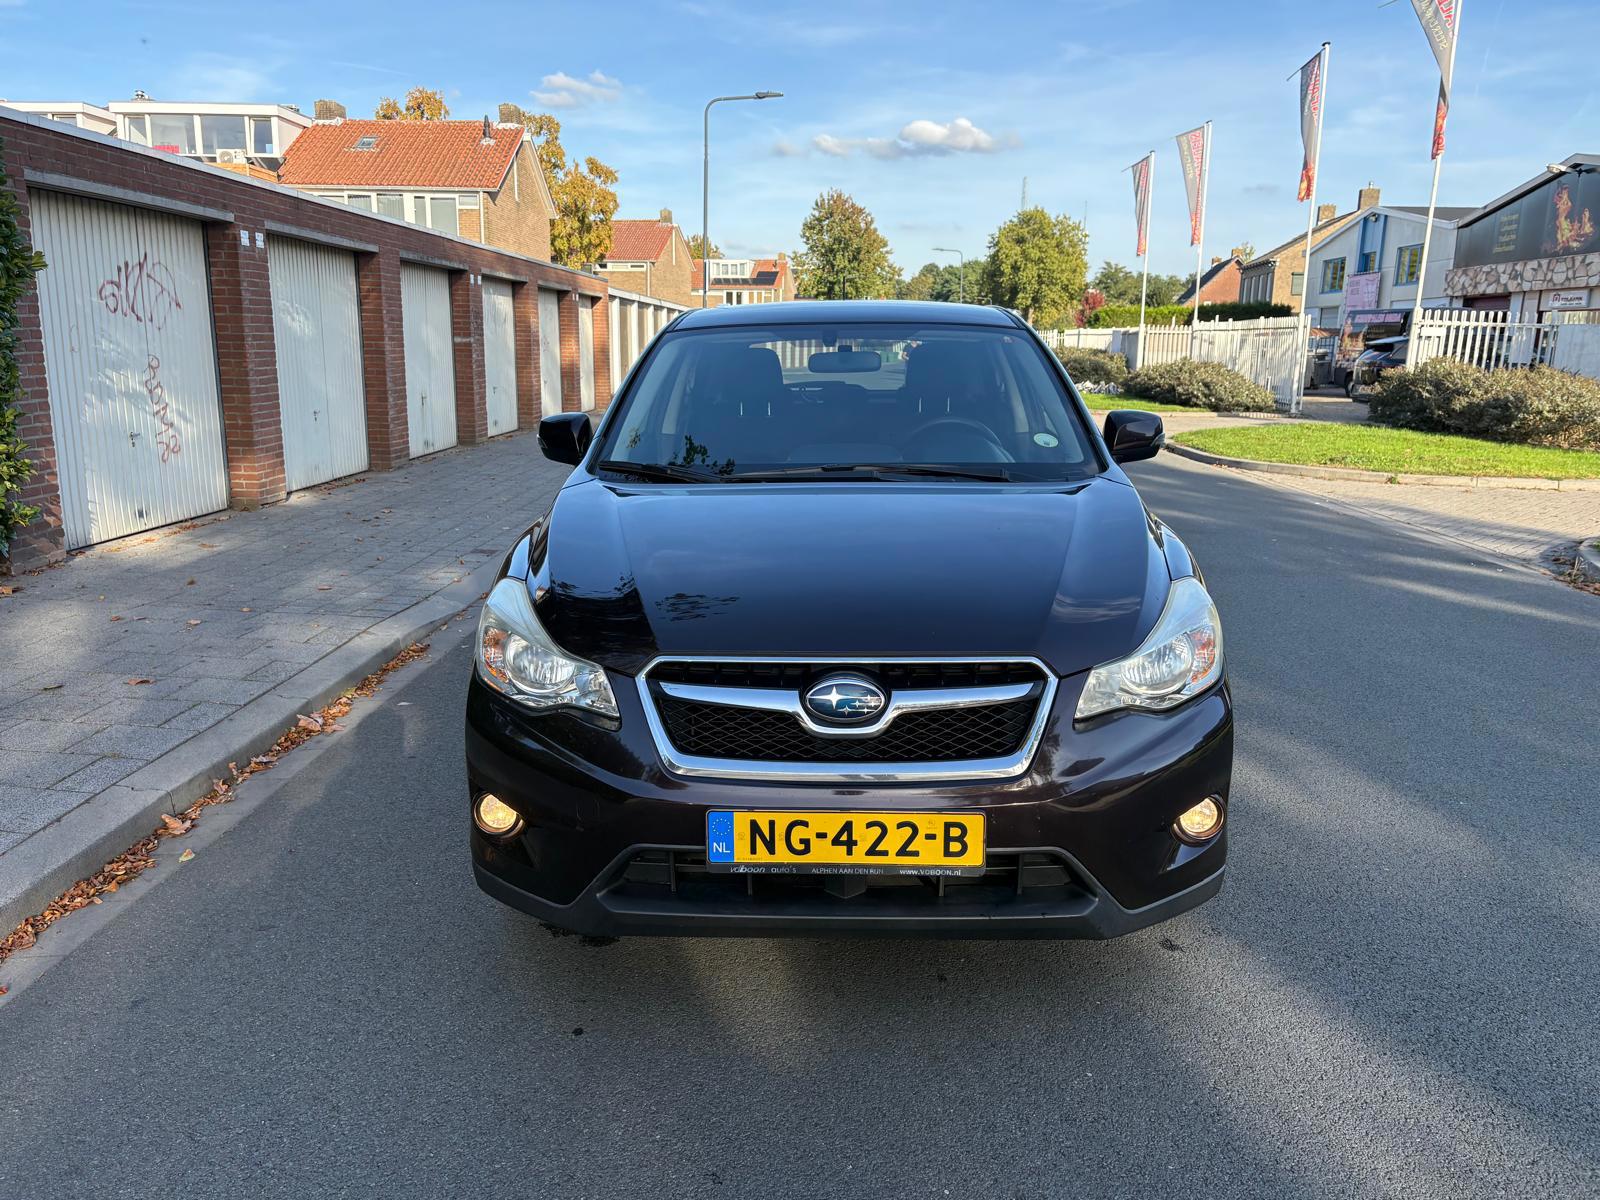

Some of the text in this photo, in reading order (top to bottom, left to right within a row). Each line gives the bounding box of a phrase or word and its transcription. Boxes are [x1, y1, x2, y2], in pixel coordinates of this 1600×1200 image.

[749, 819, 969, 858] NG-422-B
[712, 841, 731, 854] NL
[811, 867, 838, 875] ALPHEN
